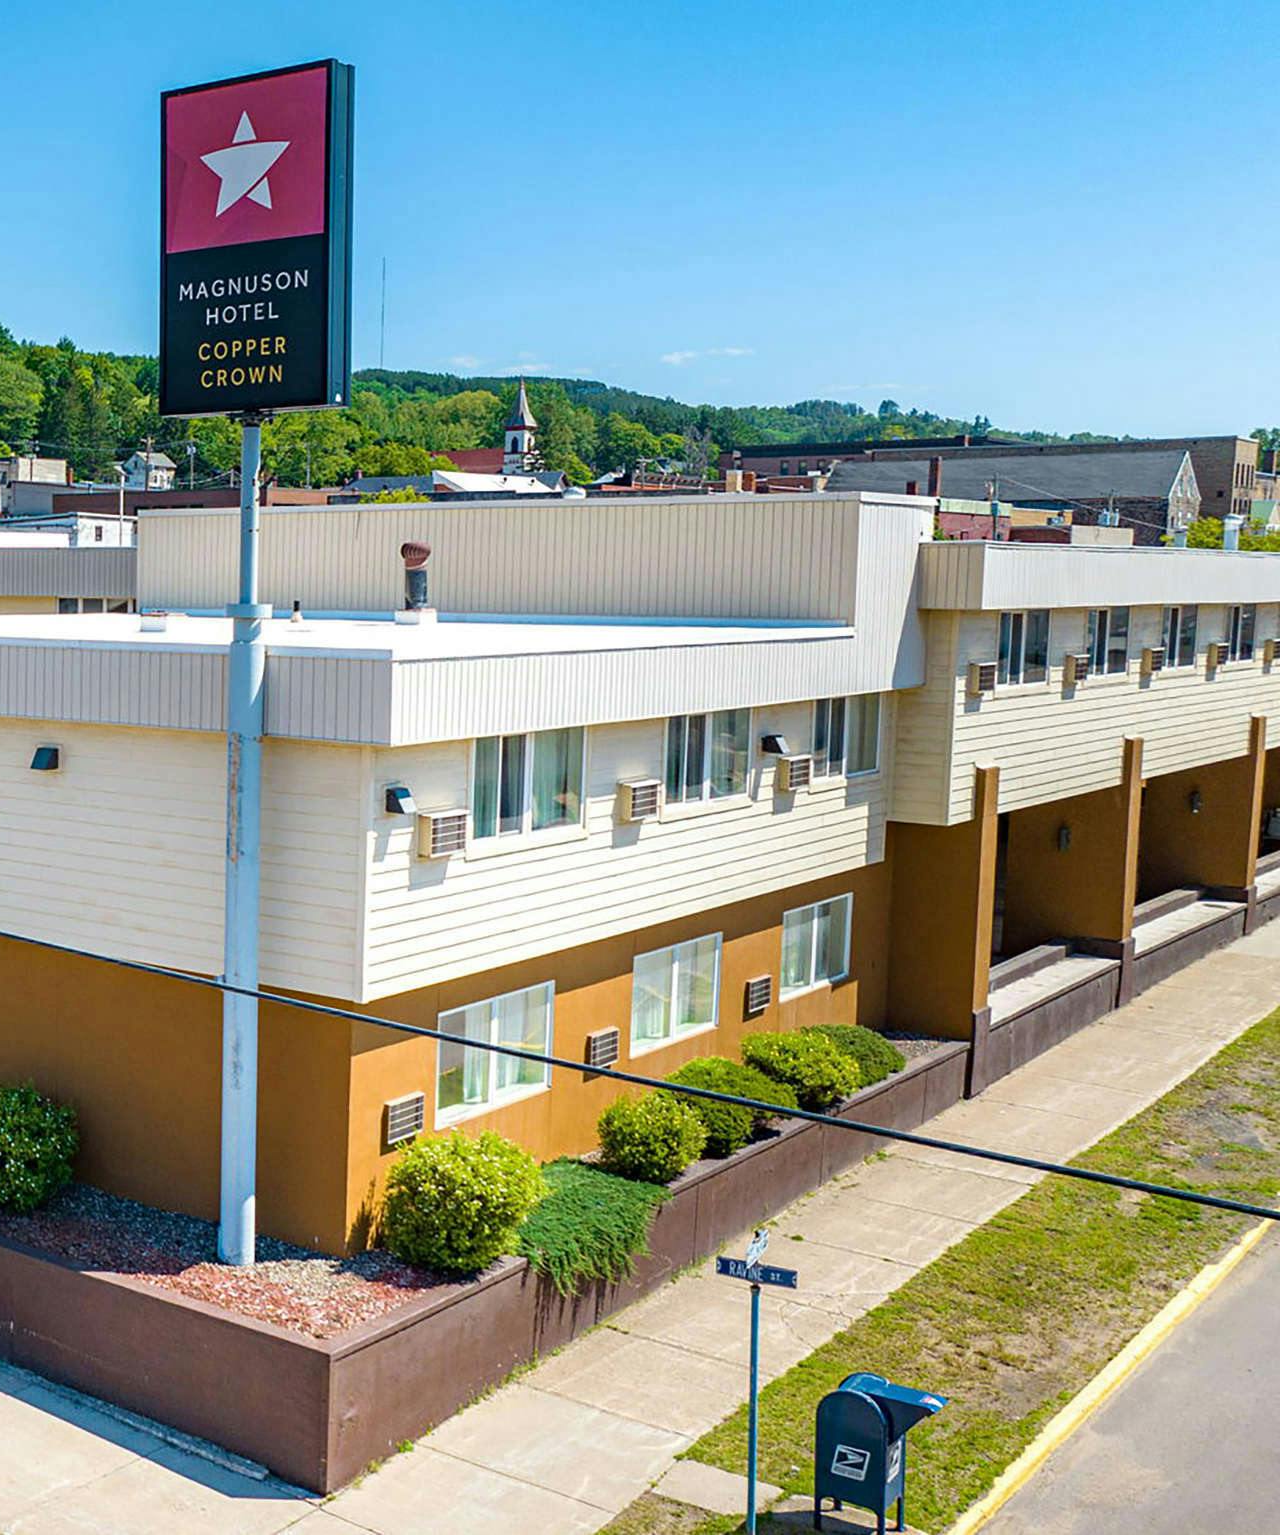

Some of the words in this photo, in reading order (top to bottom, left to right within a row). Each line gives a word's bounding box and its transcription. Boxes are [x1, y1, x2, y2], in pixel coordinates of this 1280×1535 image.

[179, 269, 309, 301] MAGNUSON
[206, 302, 279, 326] HOTEL
[198, 336, 287, 361] COPPER
[200, 365, 283, 388] CROWN
